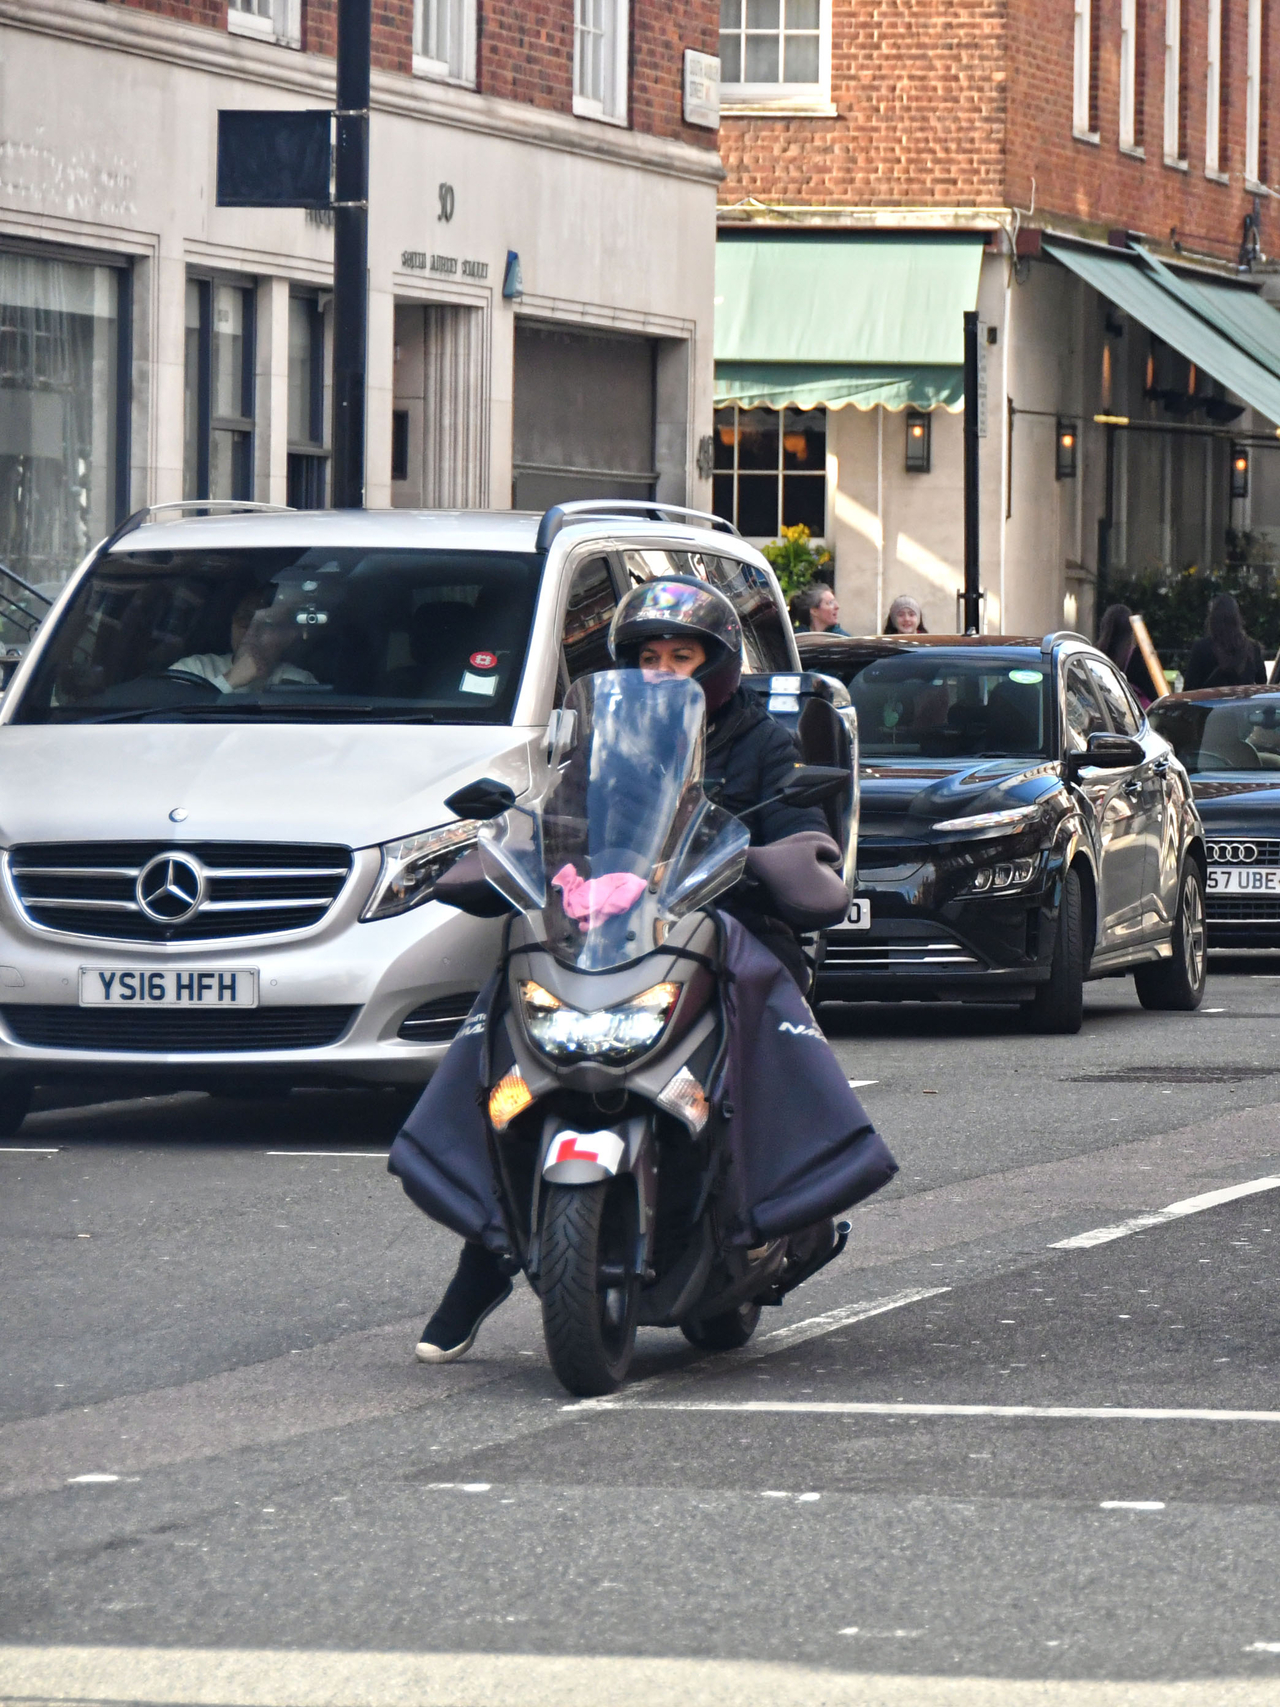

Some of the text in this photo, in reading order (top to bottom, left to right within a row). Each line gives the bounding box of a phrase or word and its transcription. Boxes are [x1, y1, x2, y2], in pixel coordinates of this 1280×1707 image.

[437, 182, 455, 223] 50
[1238, 871, 1277, 890] UBE
[98, 972, 236, 1002] YS16 HFH
[556, 1137, 599, 1163] L
